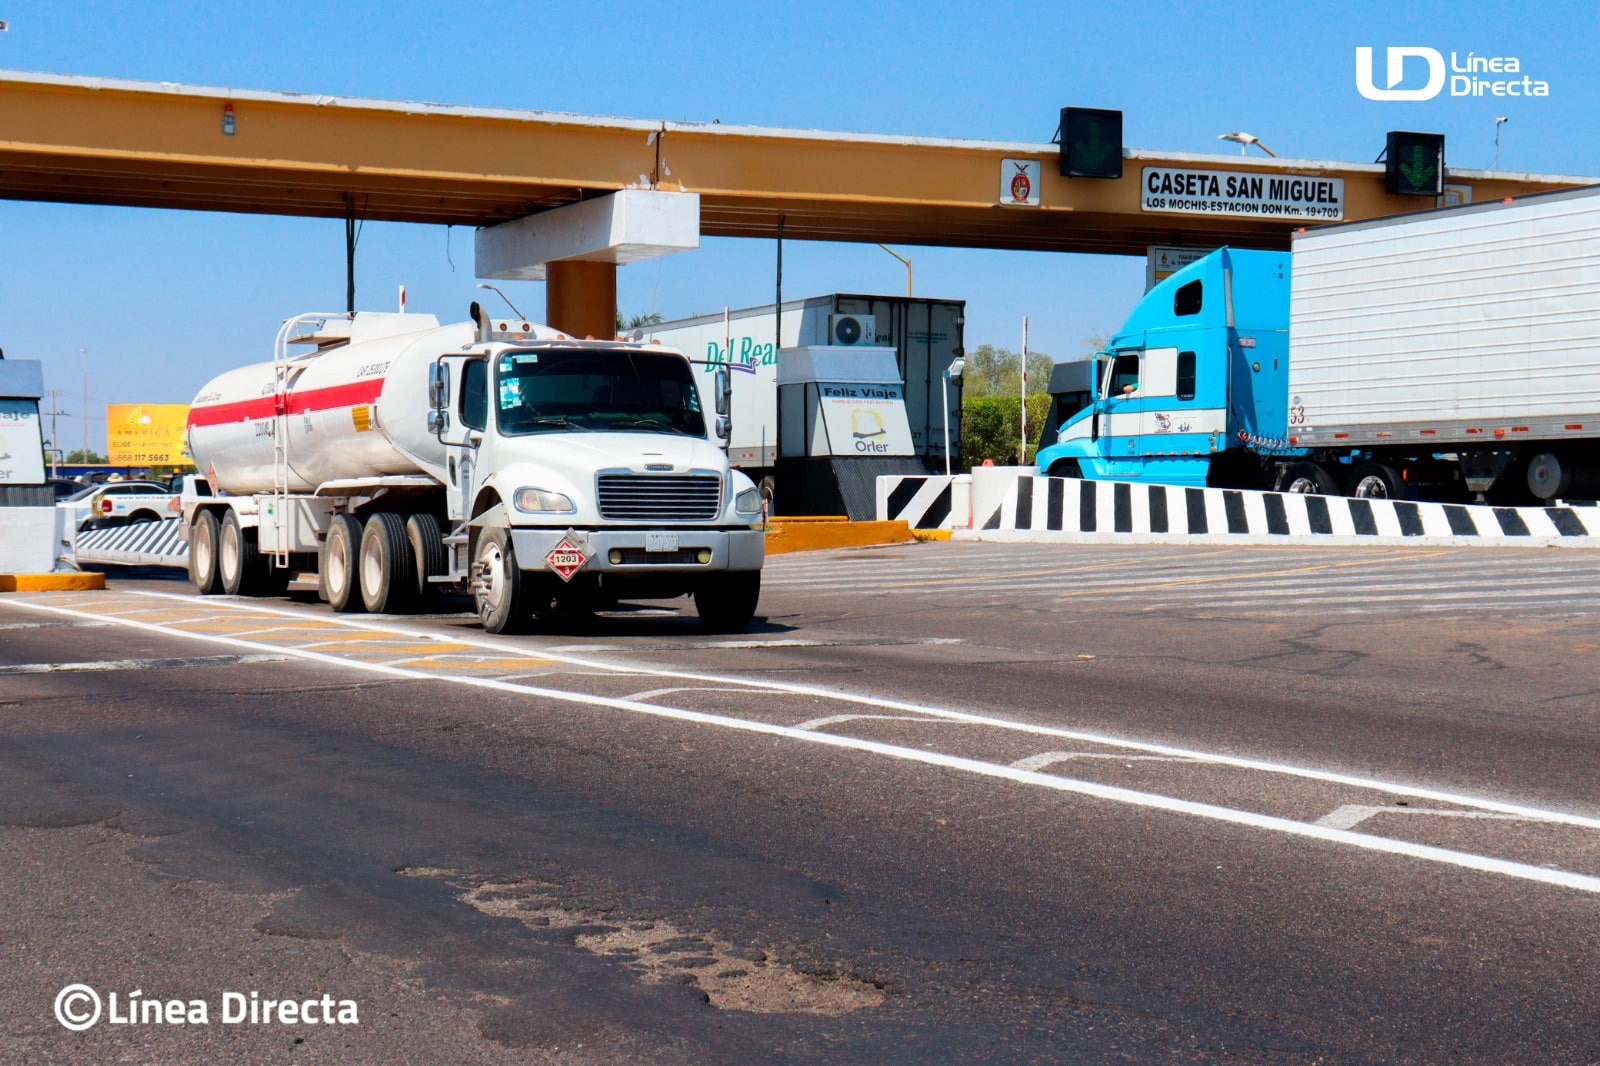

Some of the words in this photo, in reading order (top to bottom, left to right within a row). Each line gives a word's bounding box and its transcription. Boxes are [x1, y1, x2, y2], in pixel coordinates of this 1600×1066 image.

[1148, 172, 1220, 197] CASETA
[1226, 176, 1263, 200] SAN
[1269, 179, 1338, 204] MIGUEL
[1146, 197, 1166, 208] LOS
[1168, 199, 1258, 213] MOCHIS-ESTACION
[1261, 204, 1282, 215] DON
[1284, 207, 1302, 216] Km.
[1305, 207, 1339, 218] 19+700
[705, 338, 735, 373] Del
[824, 387, 857, 397] Feliz
[861, 388, 897, 399] Viaje
[0, 410, 30, 421] aje
[1290, 406, 1305, 425] 53
[855, 440, 888, 452] Orler
[134, 454, 146, 462] 117
[148, 454, 169, 462] 5663
[556, 555, 577, 563] 1203
[564, 566, 570, 574] 3
